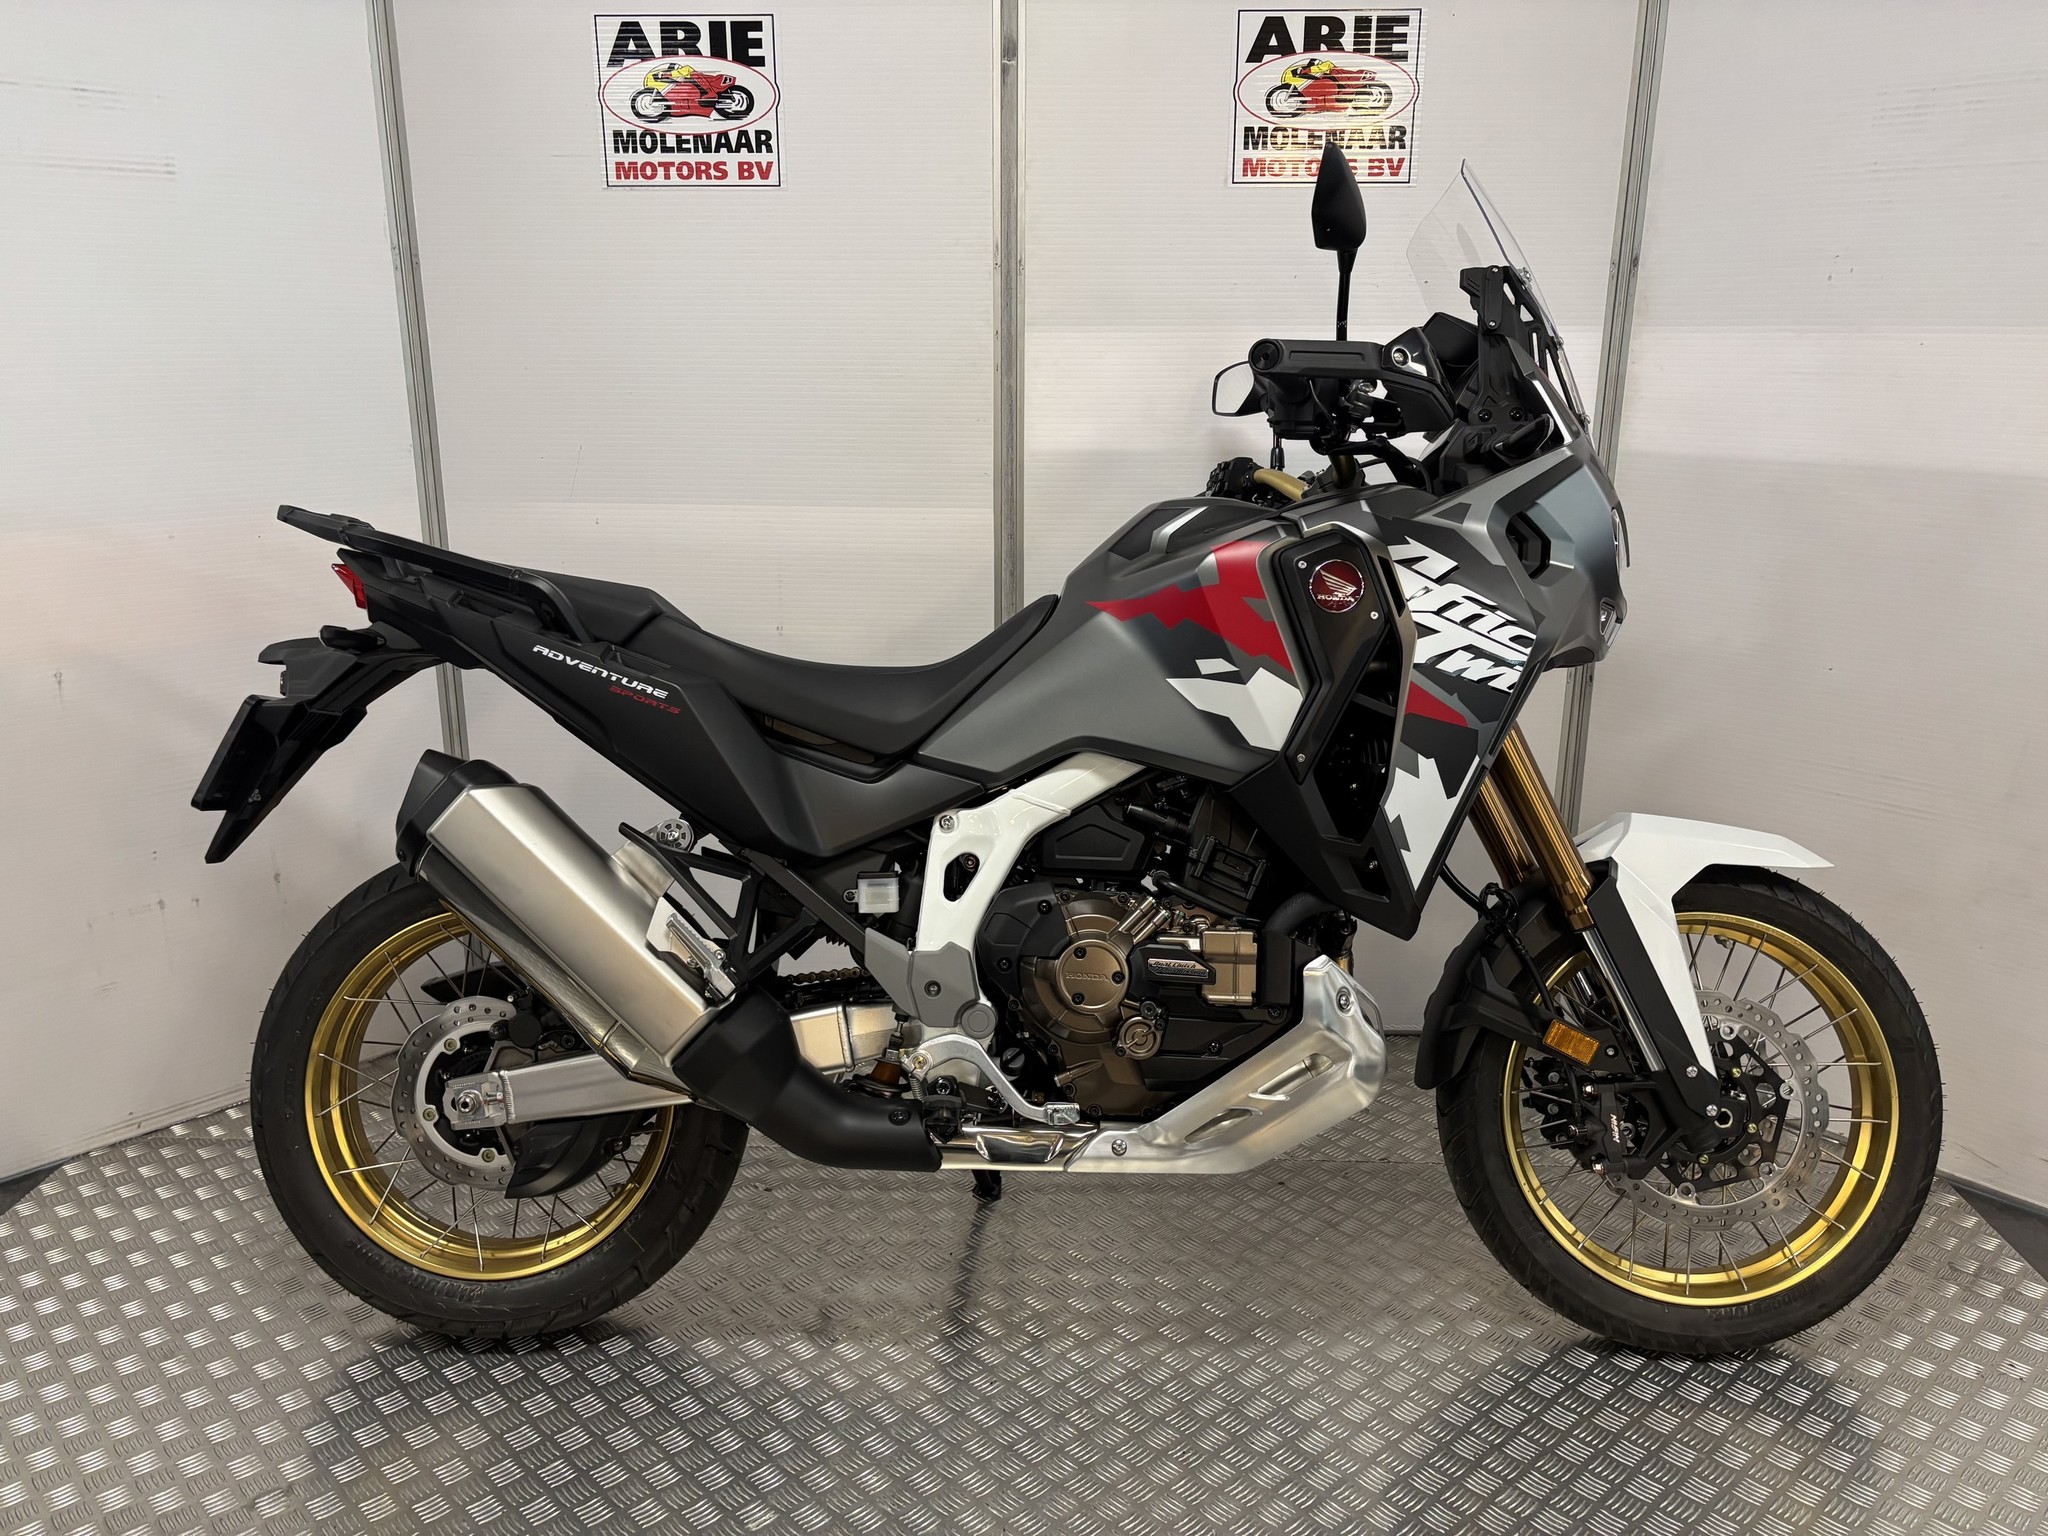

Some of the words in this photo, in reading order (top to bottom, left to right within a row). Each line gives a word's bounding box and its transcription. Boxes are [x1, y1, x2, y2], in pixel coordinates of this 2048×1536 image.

[606, 20, 766, 67] ARIE
[1245, 15, 1410, 63] ARIE
[613, 129, 773, 154] MOLENAAR
[1243, 125, 1406, 150] MOLENAAR
[615, 161, 729, 181] MOTORS
[738, 161, 774, 181] BV
[1242, 157, 1359, 177] MOTO
[1367, 157, 1406, 177] BV
[1316, 593, 1355, 602] HONDA
[532, 644, 669, 699] ADVENTURE
[608, 685, 682, 715] SPORTS
[1065, 972, 1109, 981] HONDA
